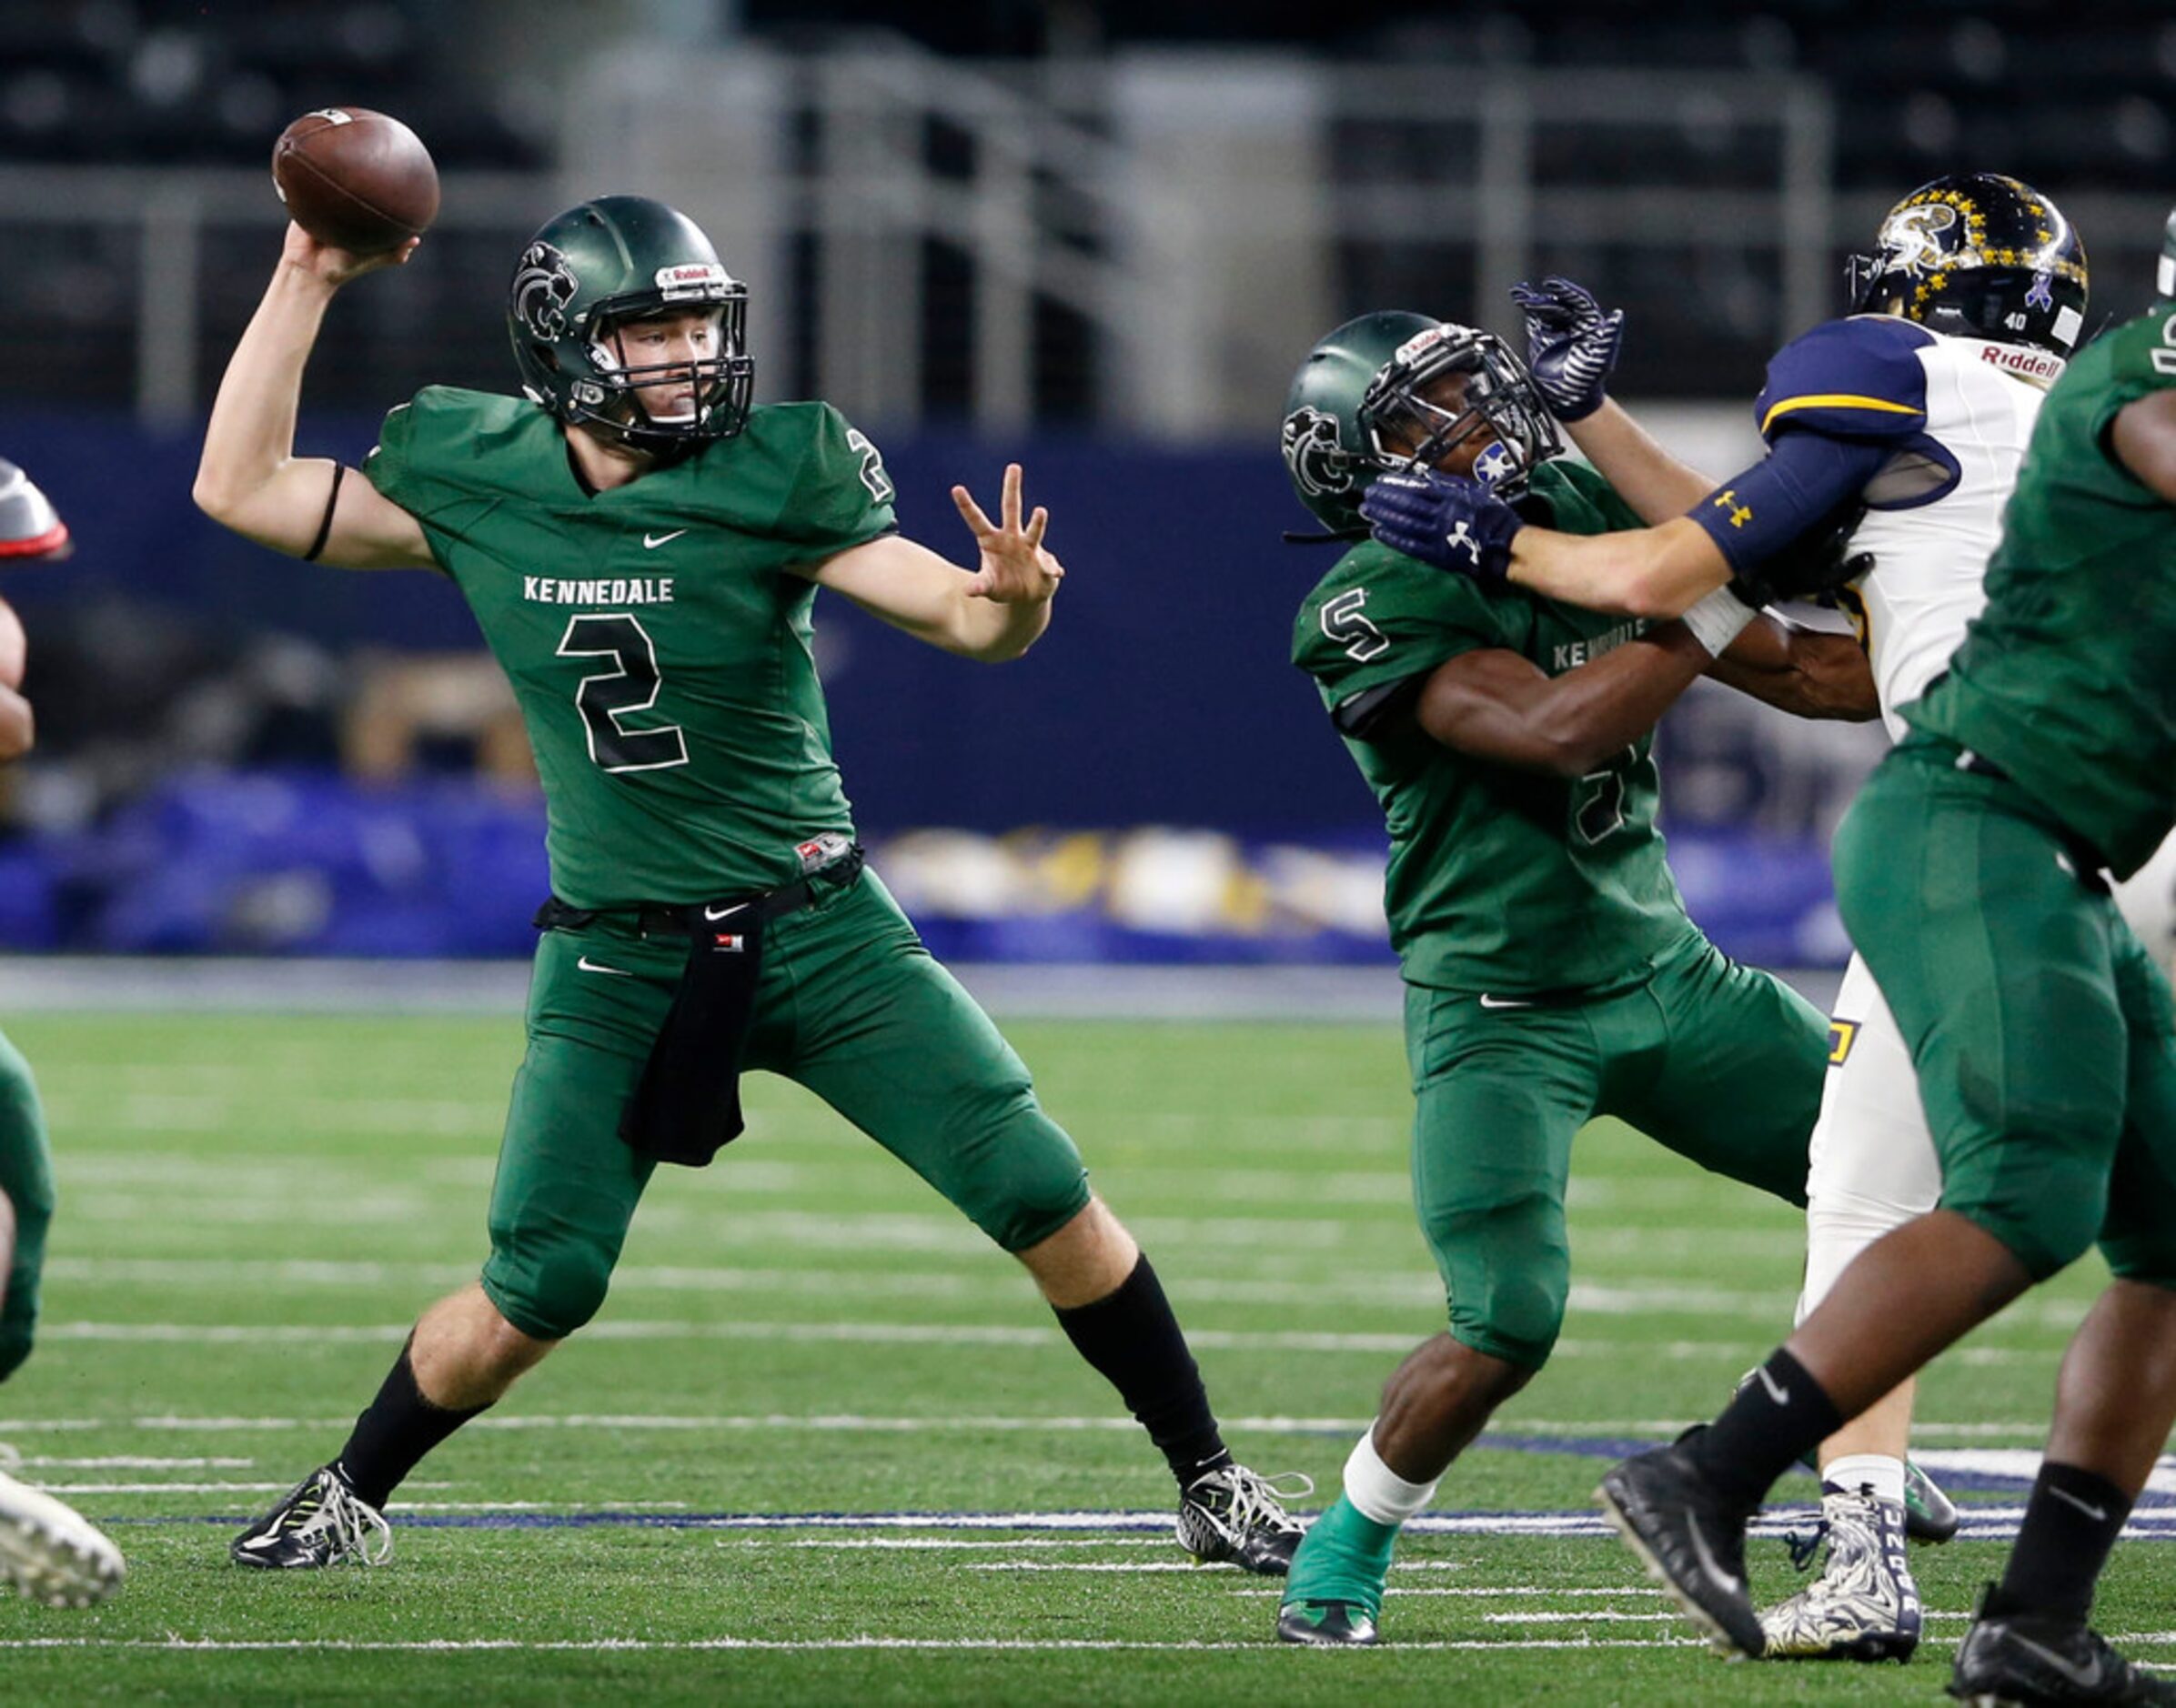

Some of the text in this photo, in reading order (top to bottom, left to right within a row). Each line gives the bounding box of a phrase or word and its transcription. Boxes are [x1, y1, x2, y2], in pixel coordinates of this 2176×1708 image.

[2003, 311, 2027, 330] 40
[1981, 346, 2060, 378] Riddell
[846, 427, 892, 502] 2
[524, 576, 674, 604] KENNEDALE
[1321, 588, 1390, 662] 5
[556, 613, 689, 772] 2
